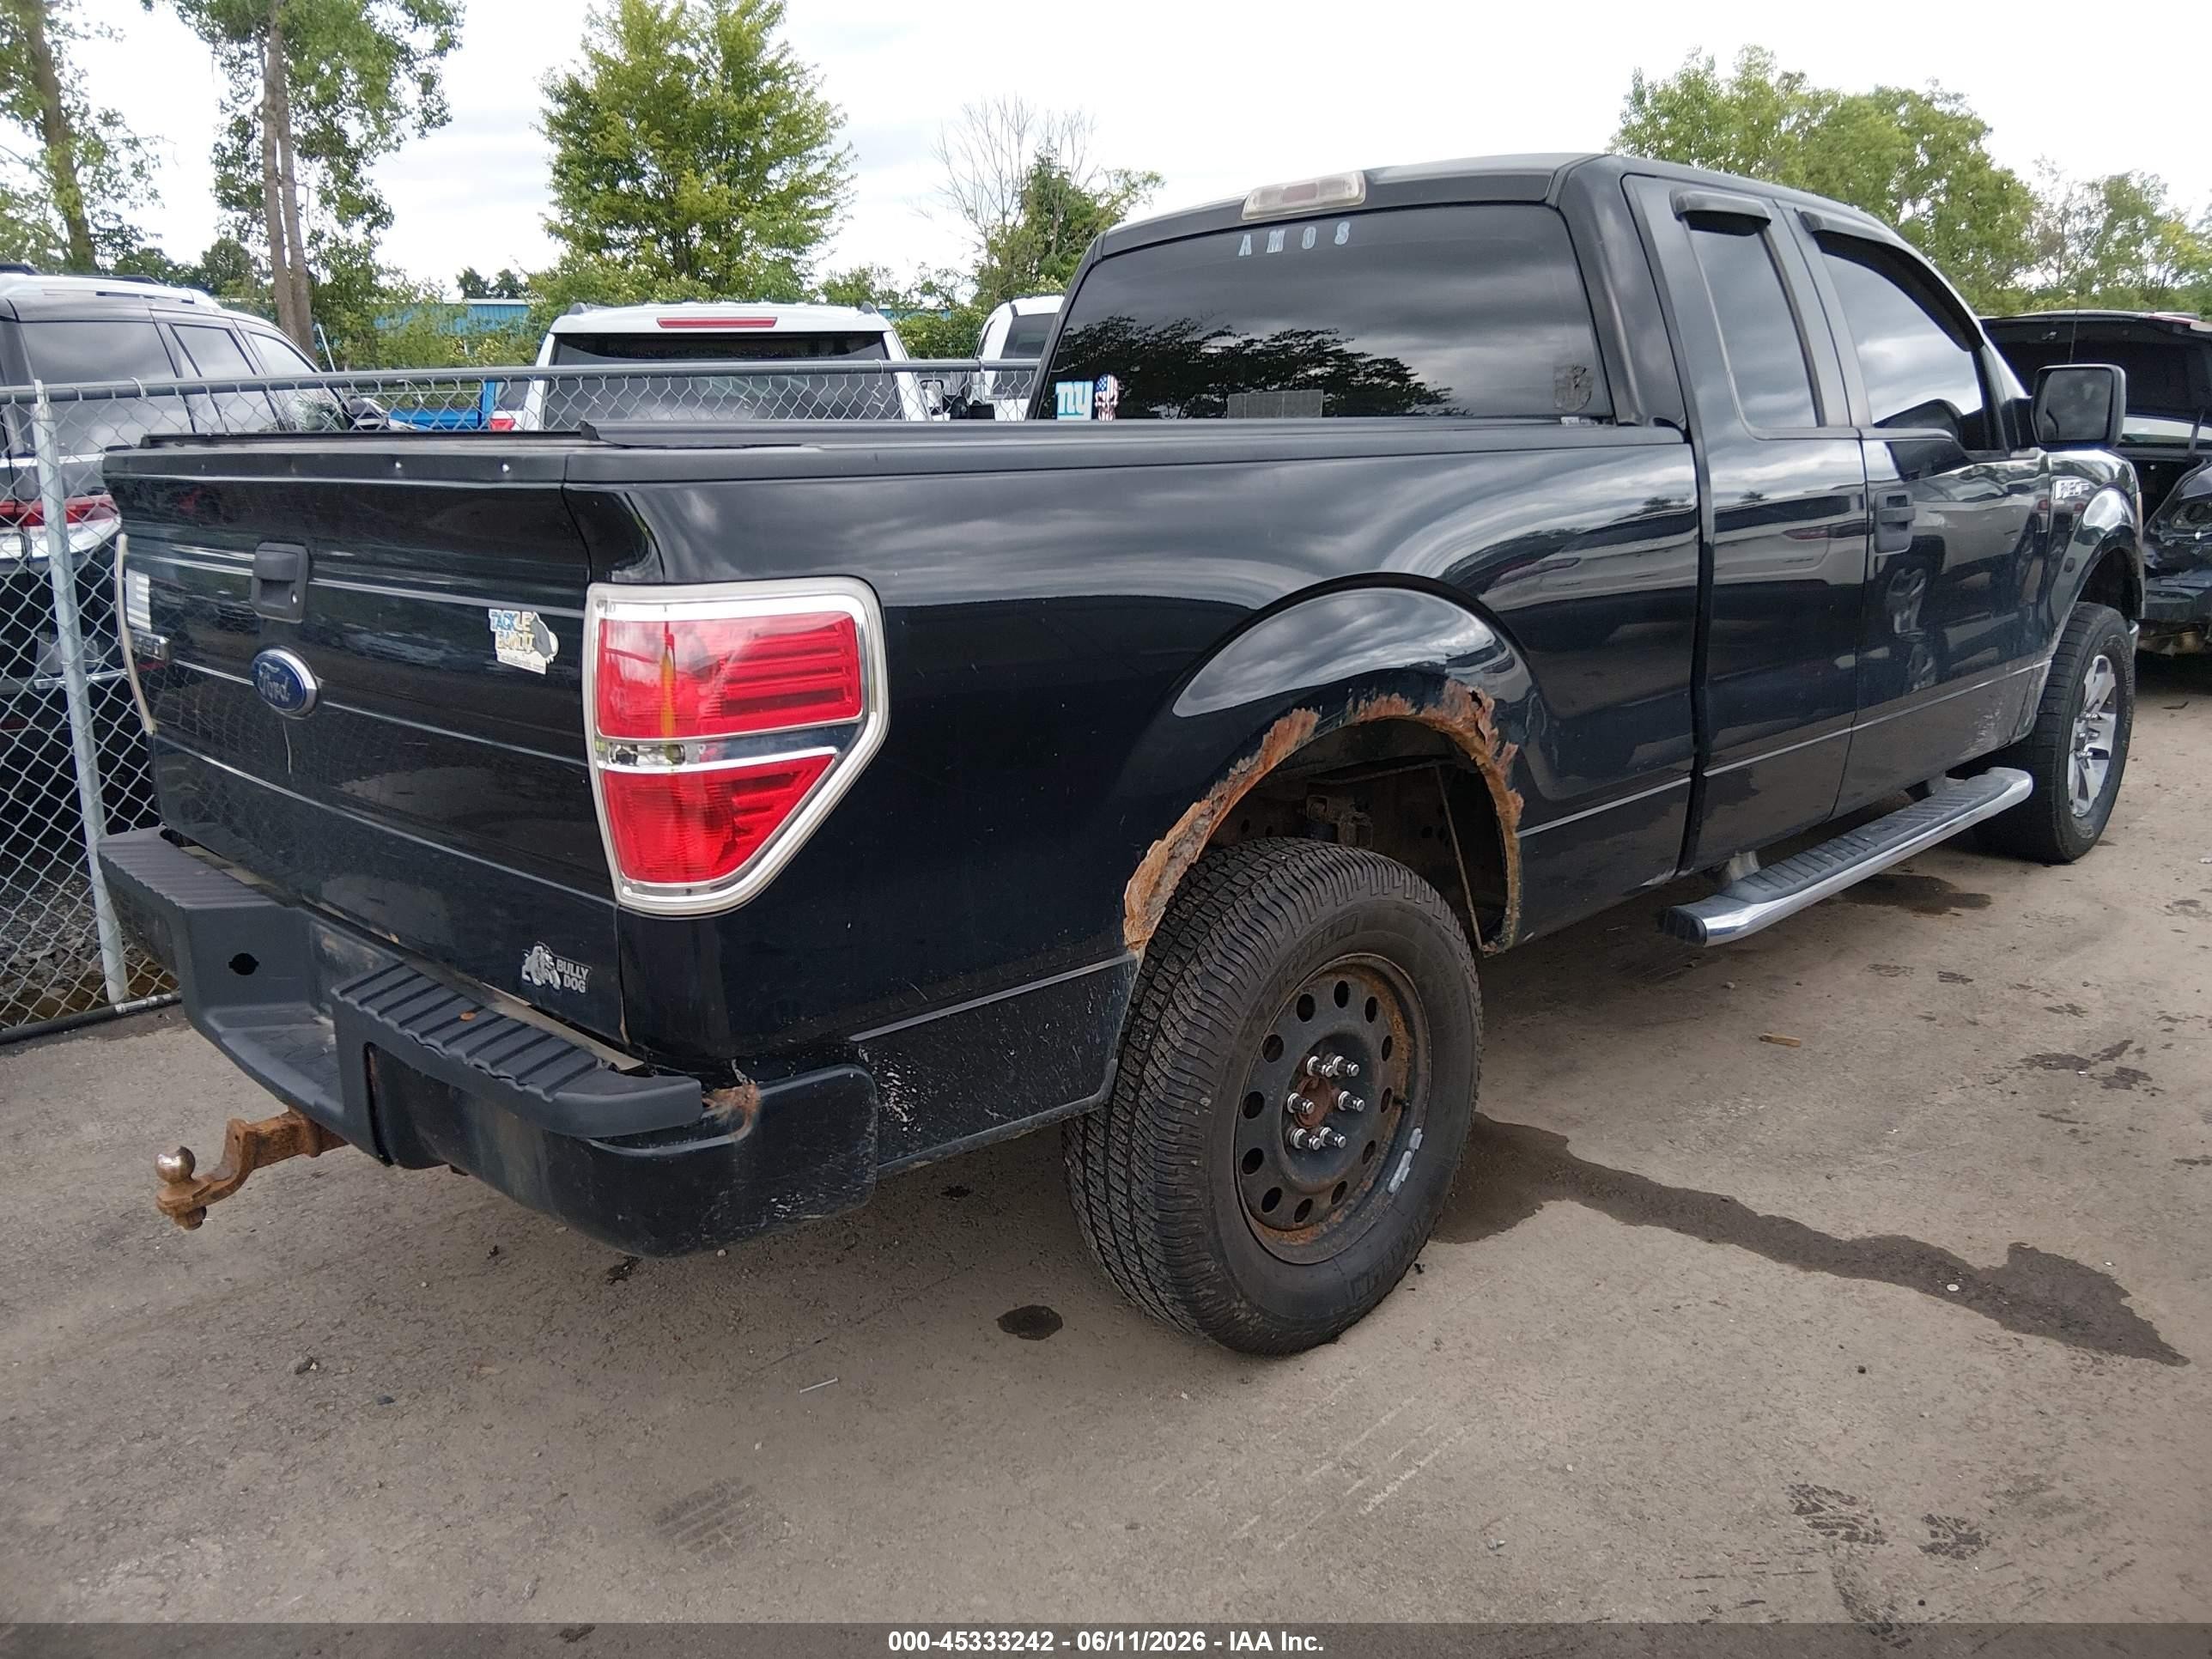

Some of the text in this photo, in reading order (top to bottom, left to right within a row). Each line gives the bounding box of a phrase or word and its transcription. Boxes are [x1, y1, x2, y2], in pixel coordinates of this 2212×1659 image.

[1237, 221, 1352, 257] AMOS
[258, 661, 290, 702] Ford
[556, 959, 589, 981] BULLY
[564, 975, 586, 993] DOG
